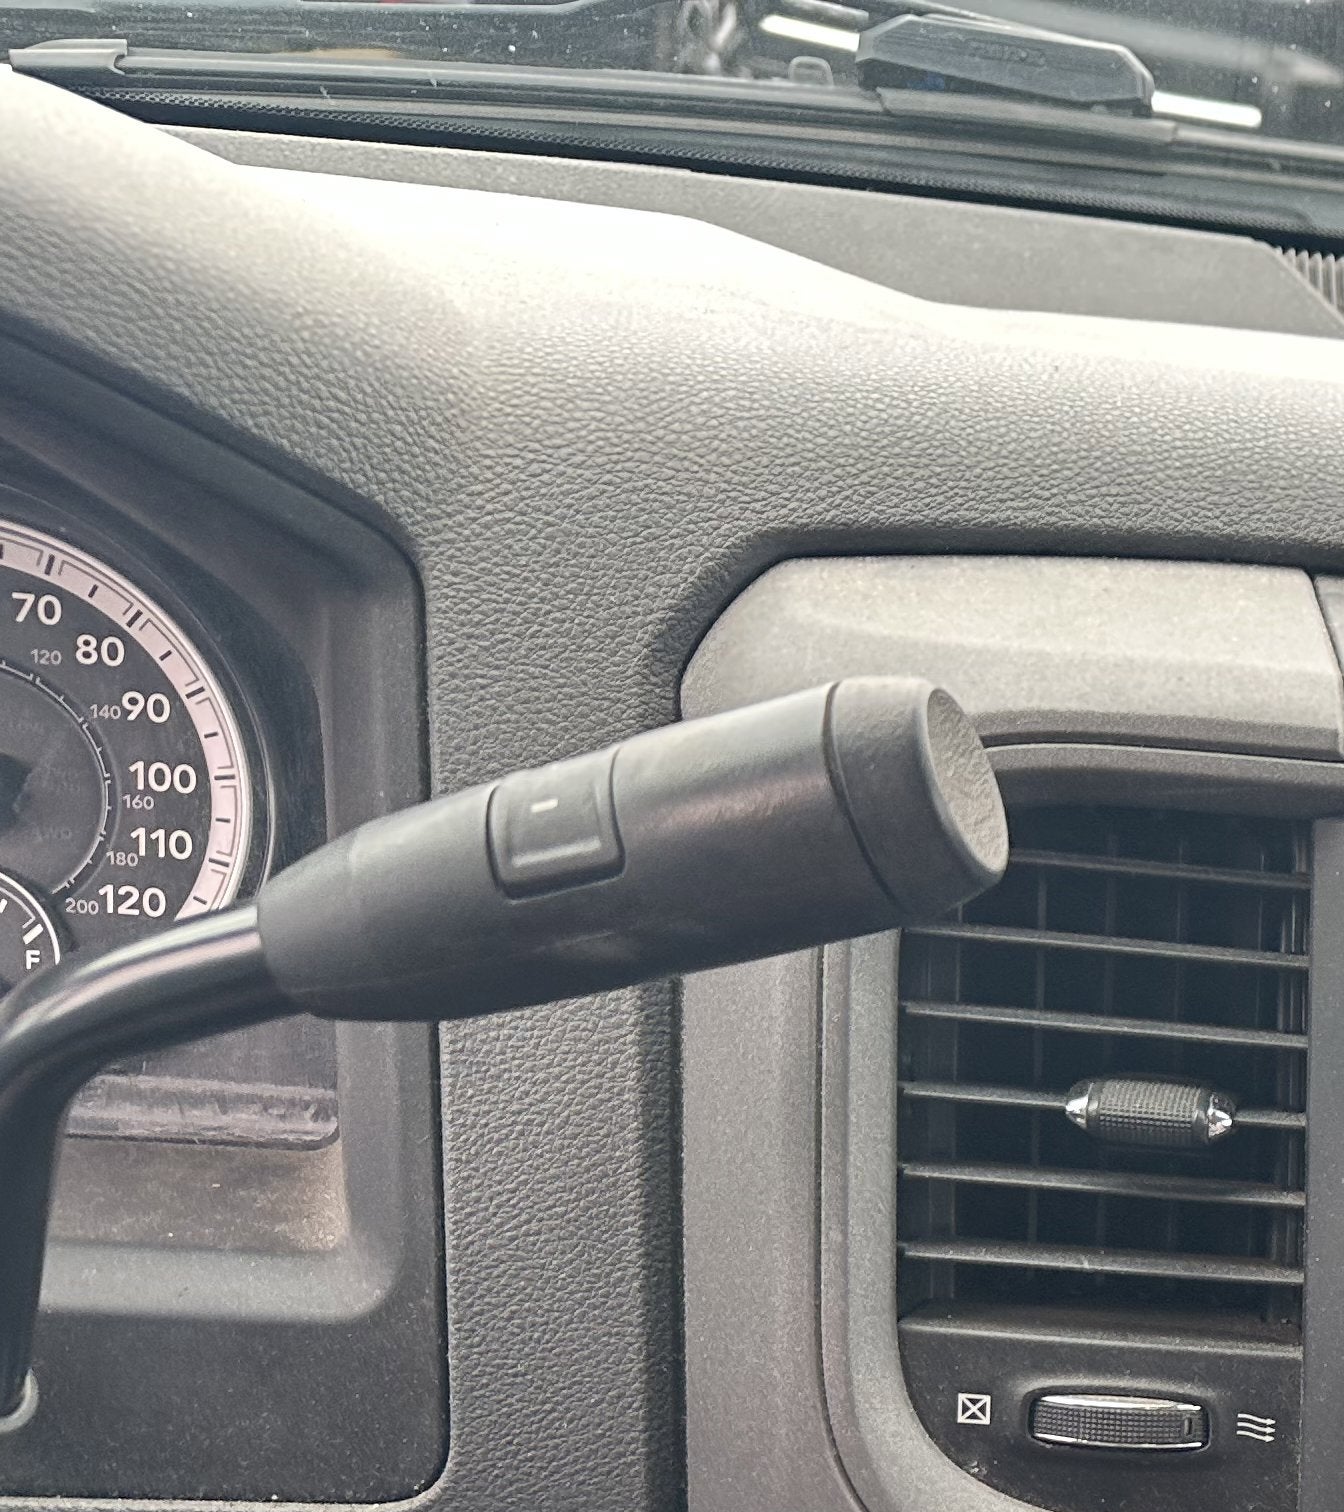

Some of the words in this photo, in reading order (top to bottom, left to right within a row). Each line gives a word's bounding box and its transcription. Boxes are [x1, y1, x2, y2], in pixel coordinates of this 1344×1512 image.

[12, 593, 62, 626] 70
[31, 649, 62, 665] 120
[75, 636, 125, 667] 80
[90, 704, 121, 720] 140
[121, 692, 170, 722] 90
[129, 761, 197, 795] 100
[123, 795, 154, 811] 160
[131, 827, 193, 860] 110
[107, 851, 138, 867] 180
[66, 897, 99, 915] 200
[99, 884, 167, 918] 120
[26, 950, 41, 970] F
